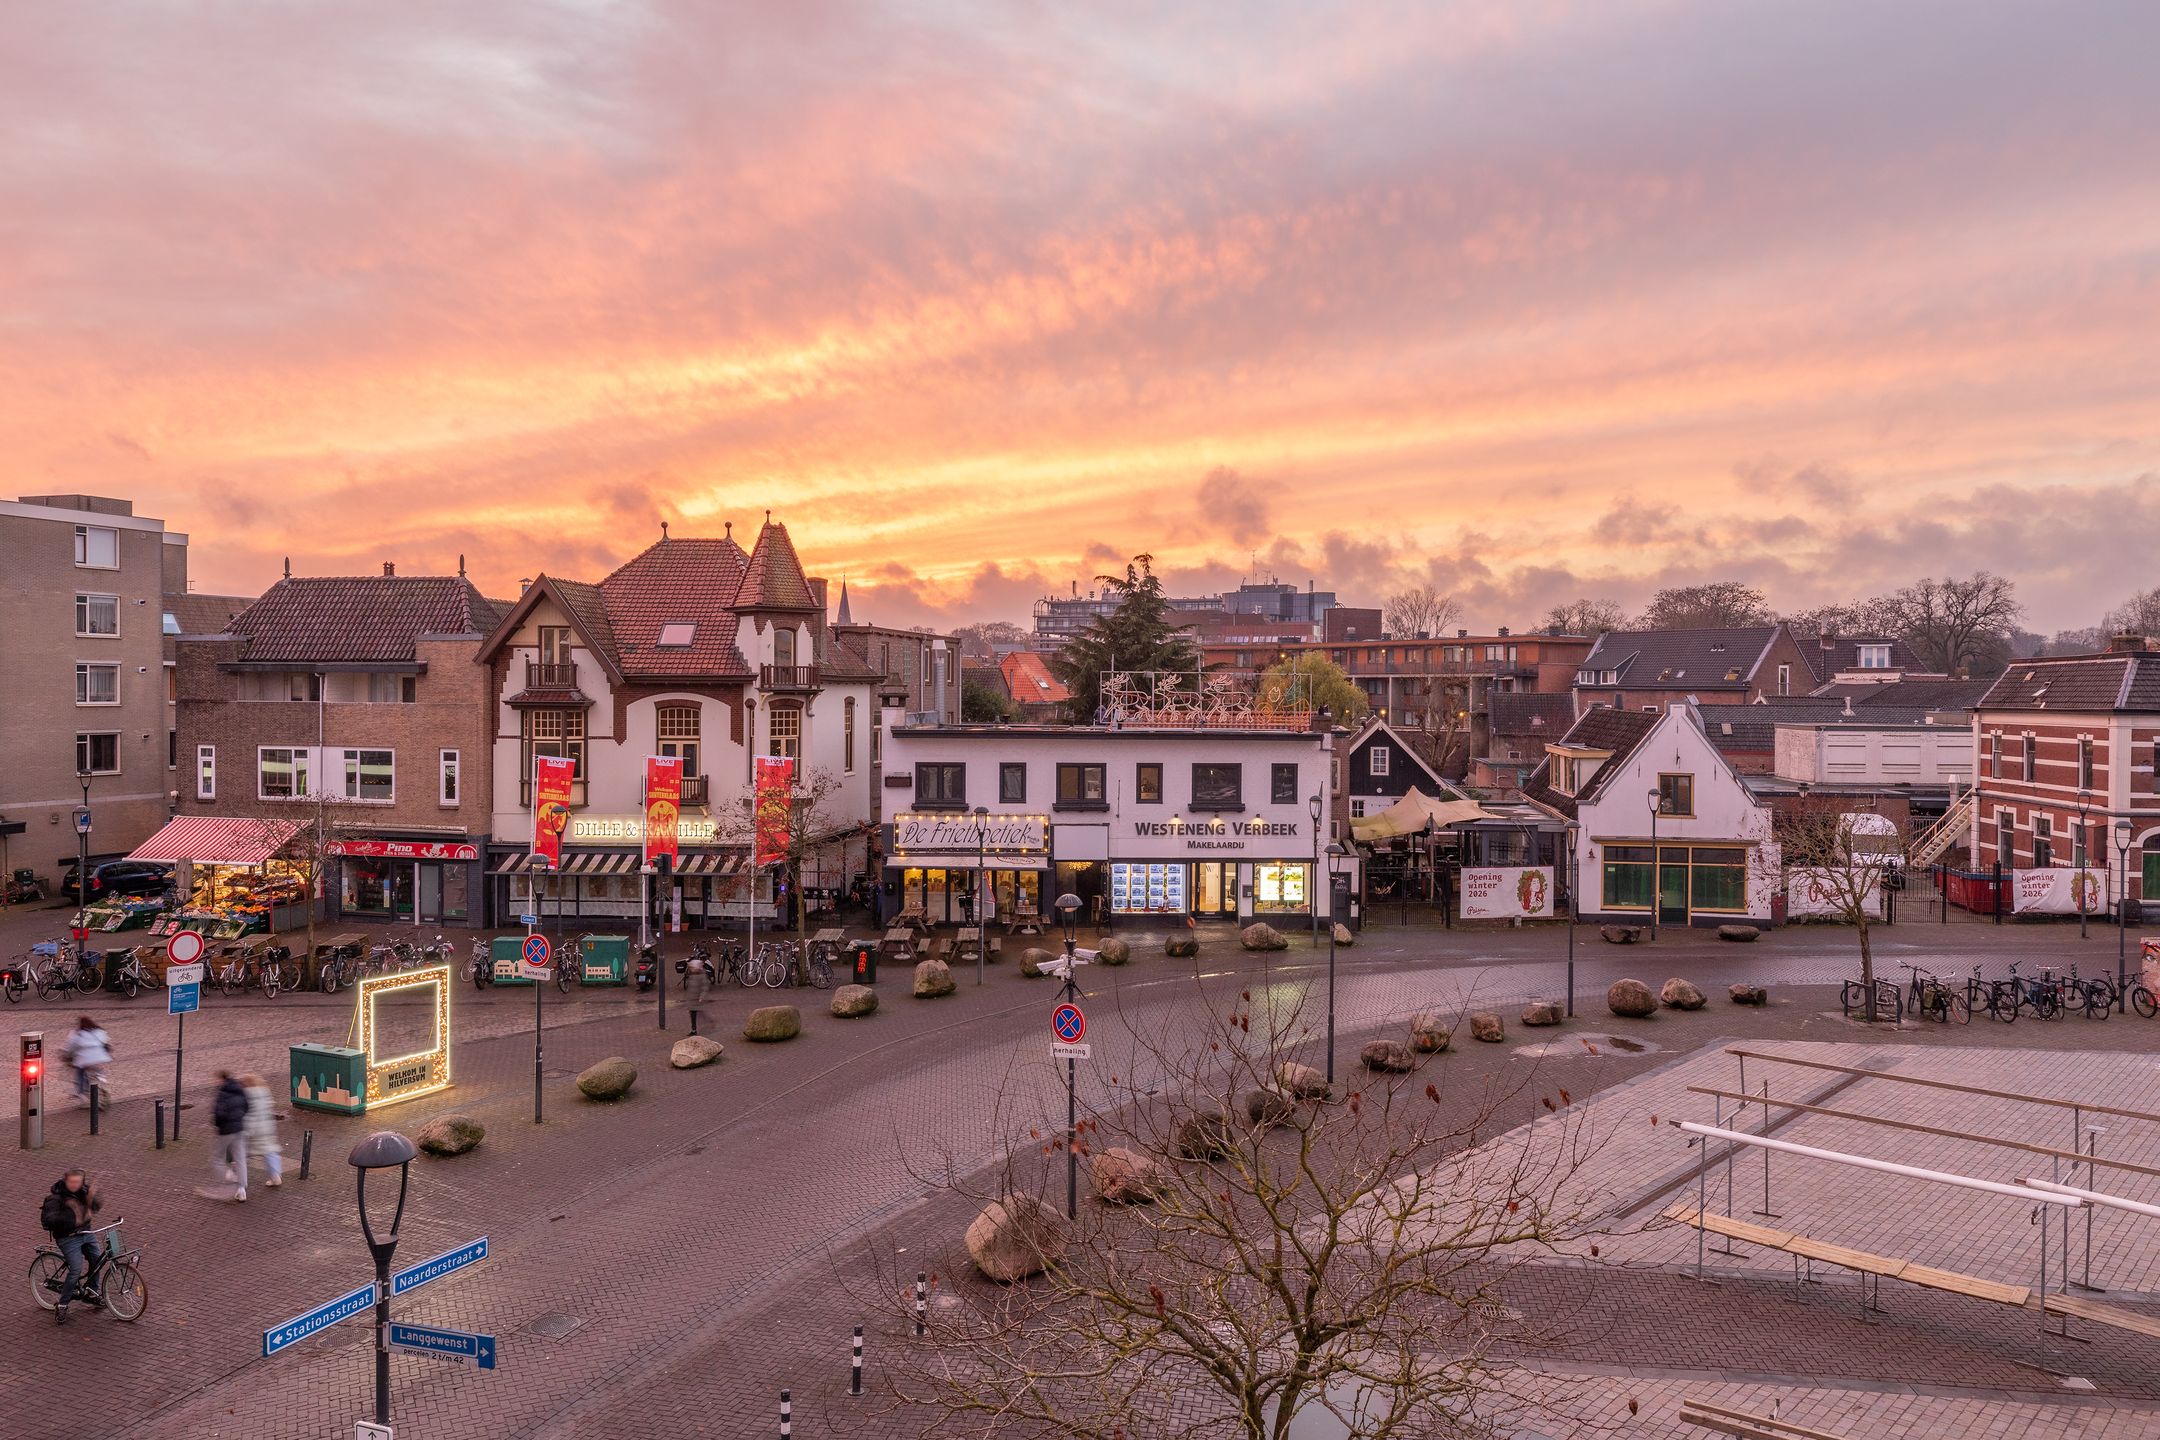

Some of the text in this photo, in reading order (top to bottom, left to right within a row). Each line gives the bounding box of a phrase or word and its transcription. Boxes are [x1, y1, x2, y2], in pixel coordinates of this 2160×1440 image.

[574, 822, 714, 838] DILLE & KAMILLE
[902, 821, 927, 846] De
[1135, 822, 1298, 836] WESTENENG VERBEEK
[386, 843, 413, 852] Pino
[1187, 840, 1245, 849] MAKELAARDIJ
[1468, 873, 1503, 882] Opening
[2021, 873, 2055, 883] Opening
[1468, 881, 1497, 889] winter
[2021, 881, 2051, 889] winter
[1468, 890, 1488, 898] 2026
[2022, 890, 2043, 898] 2026
[169, 965, 202, 974] uitgezonderd
[1053, 1047, 1086, 1056] herhaling
[388, 1065, 426, 1081] WELKOM IN
[388, 1073, 426, 1090] HILVERSUM
[399, 1250, 473, 1288] Naarderstraat
[285, 1293, 370, 1341] Stationsstraat
[399, 1328, 468, 1350] Langgewenst
[403, 1348, 464, 1364] percelen 2 t/m 42
